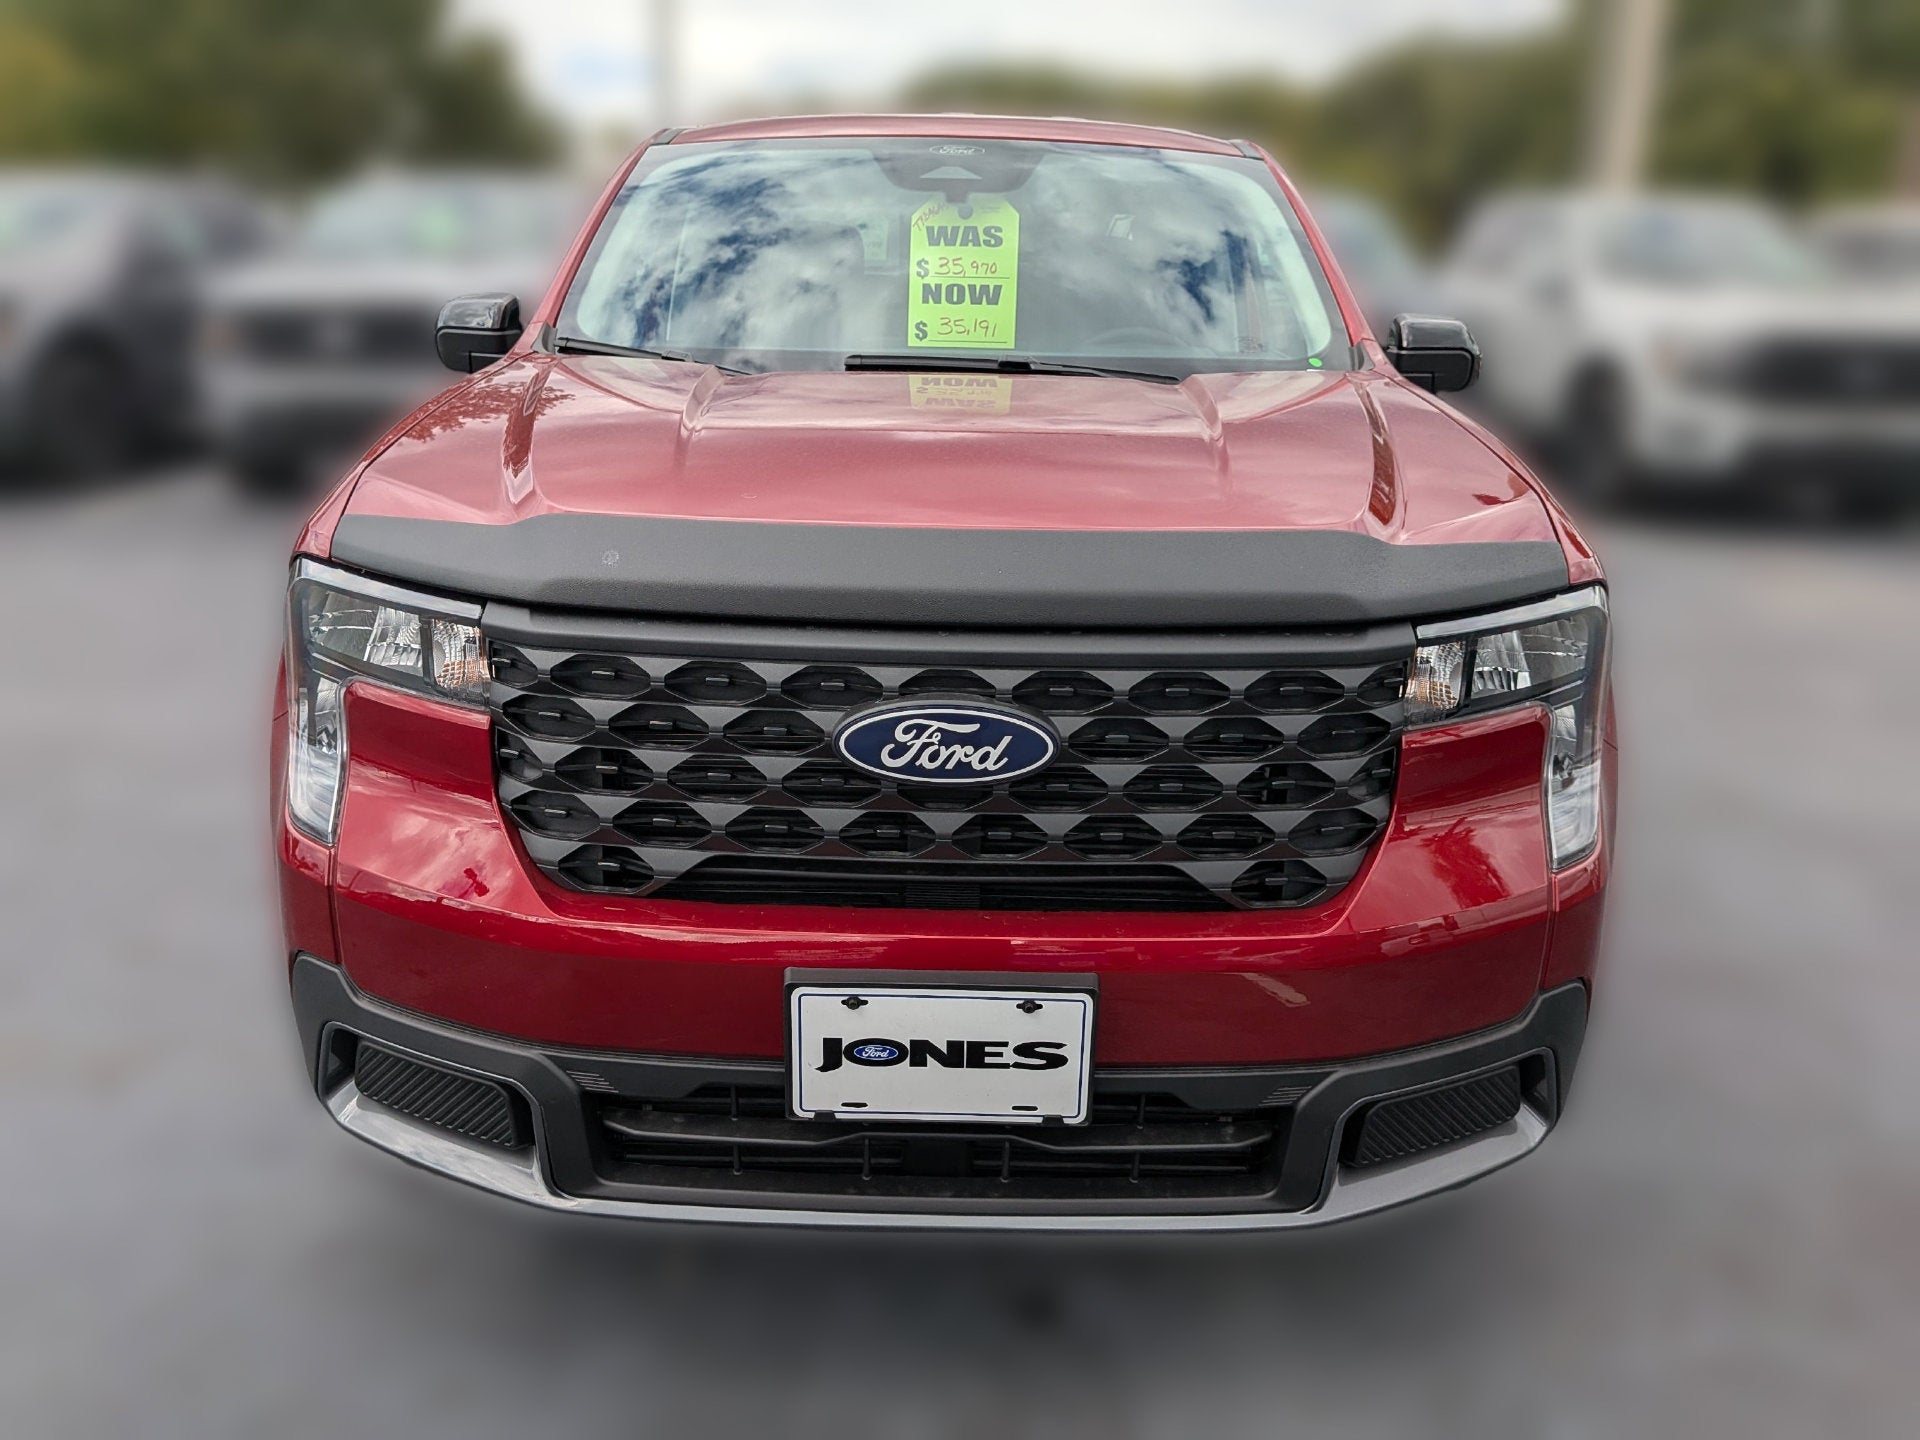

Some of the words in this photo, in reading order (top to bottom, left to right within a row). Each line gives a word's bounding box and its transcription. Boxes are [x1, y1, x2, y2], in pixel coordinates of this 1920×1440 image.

[939, 145, 976, 155] Ford
[925, 225, 1004, 248] WAS
[916, 257, 930, 279] $
[934, 256, 998, 278] 35,970
[921, 283, 1003, 305] NOW
[914, 320, 928, 341] $
[937, 317, 997, 337] 35,191
[880, 718, 1013, 771] Ford
[814, 1037, 1069, 1072] JONES
[862, 1044, 890, 1059] Ford
